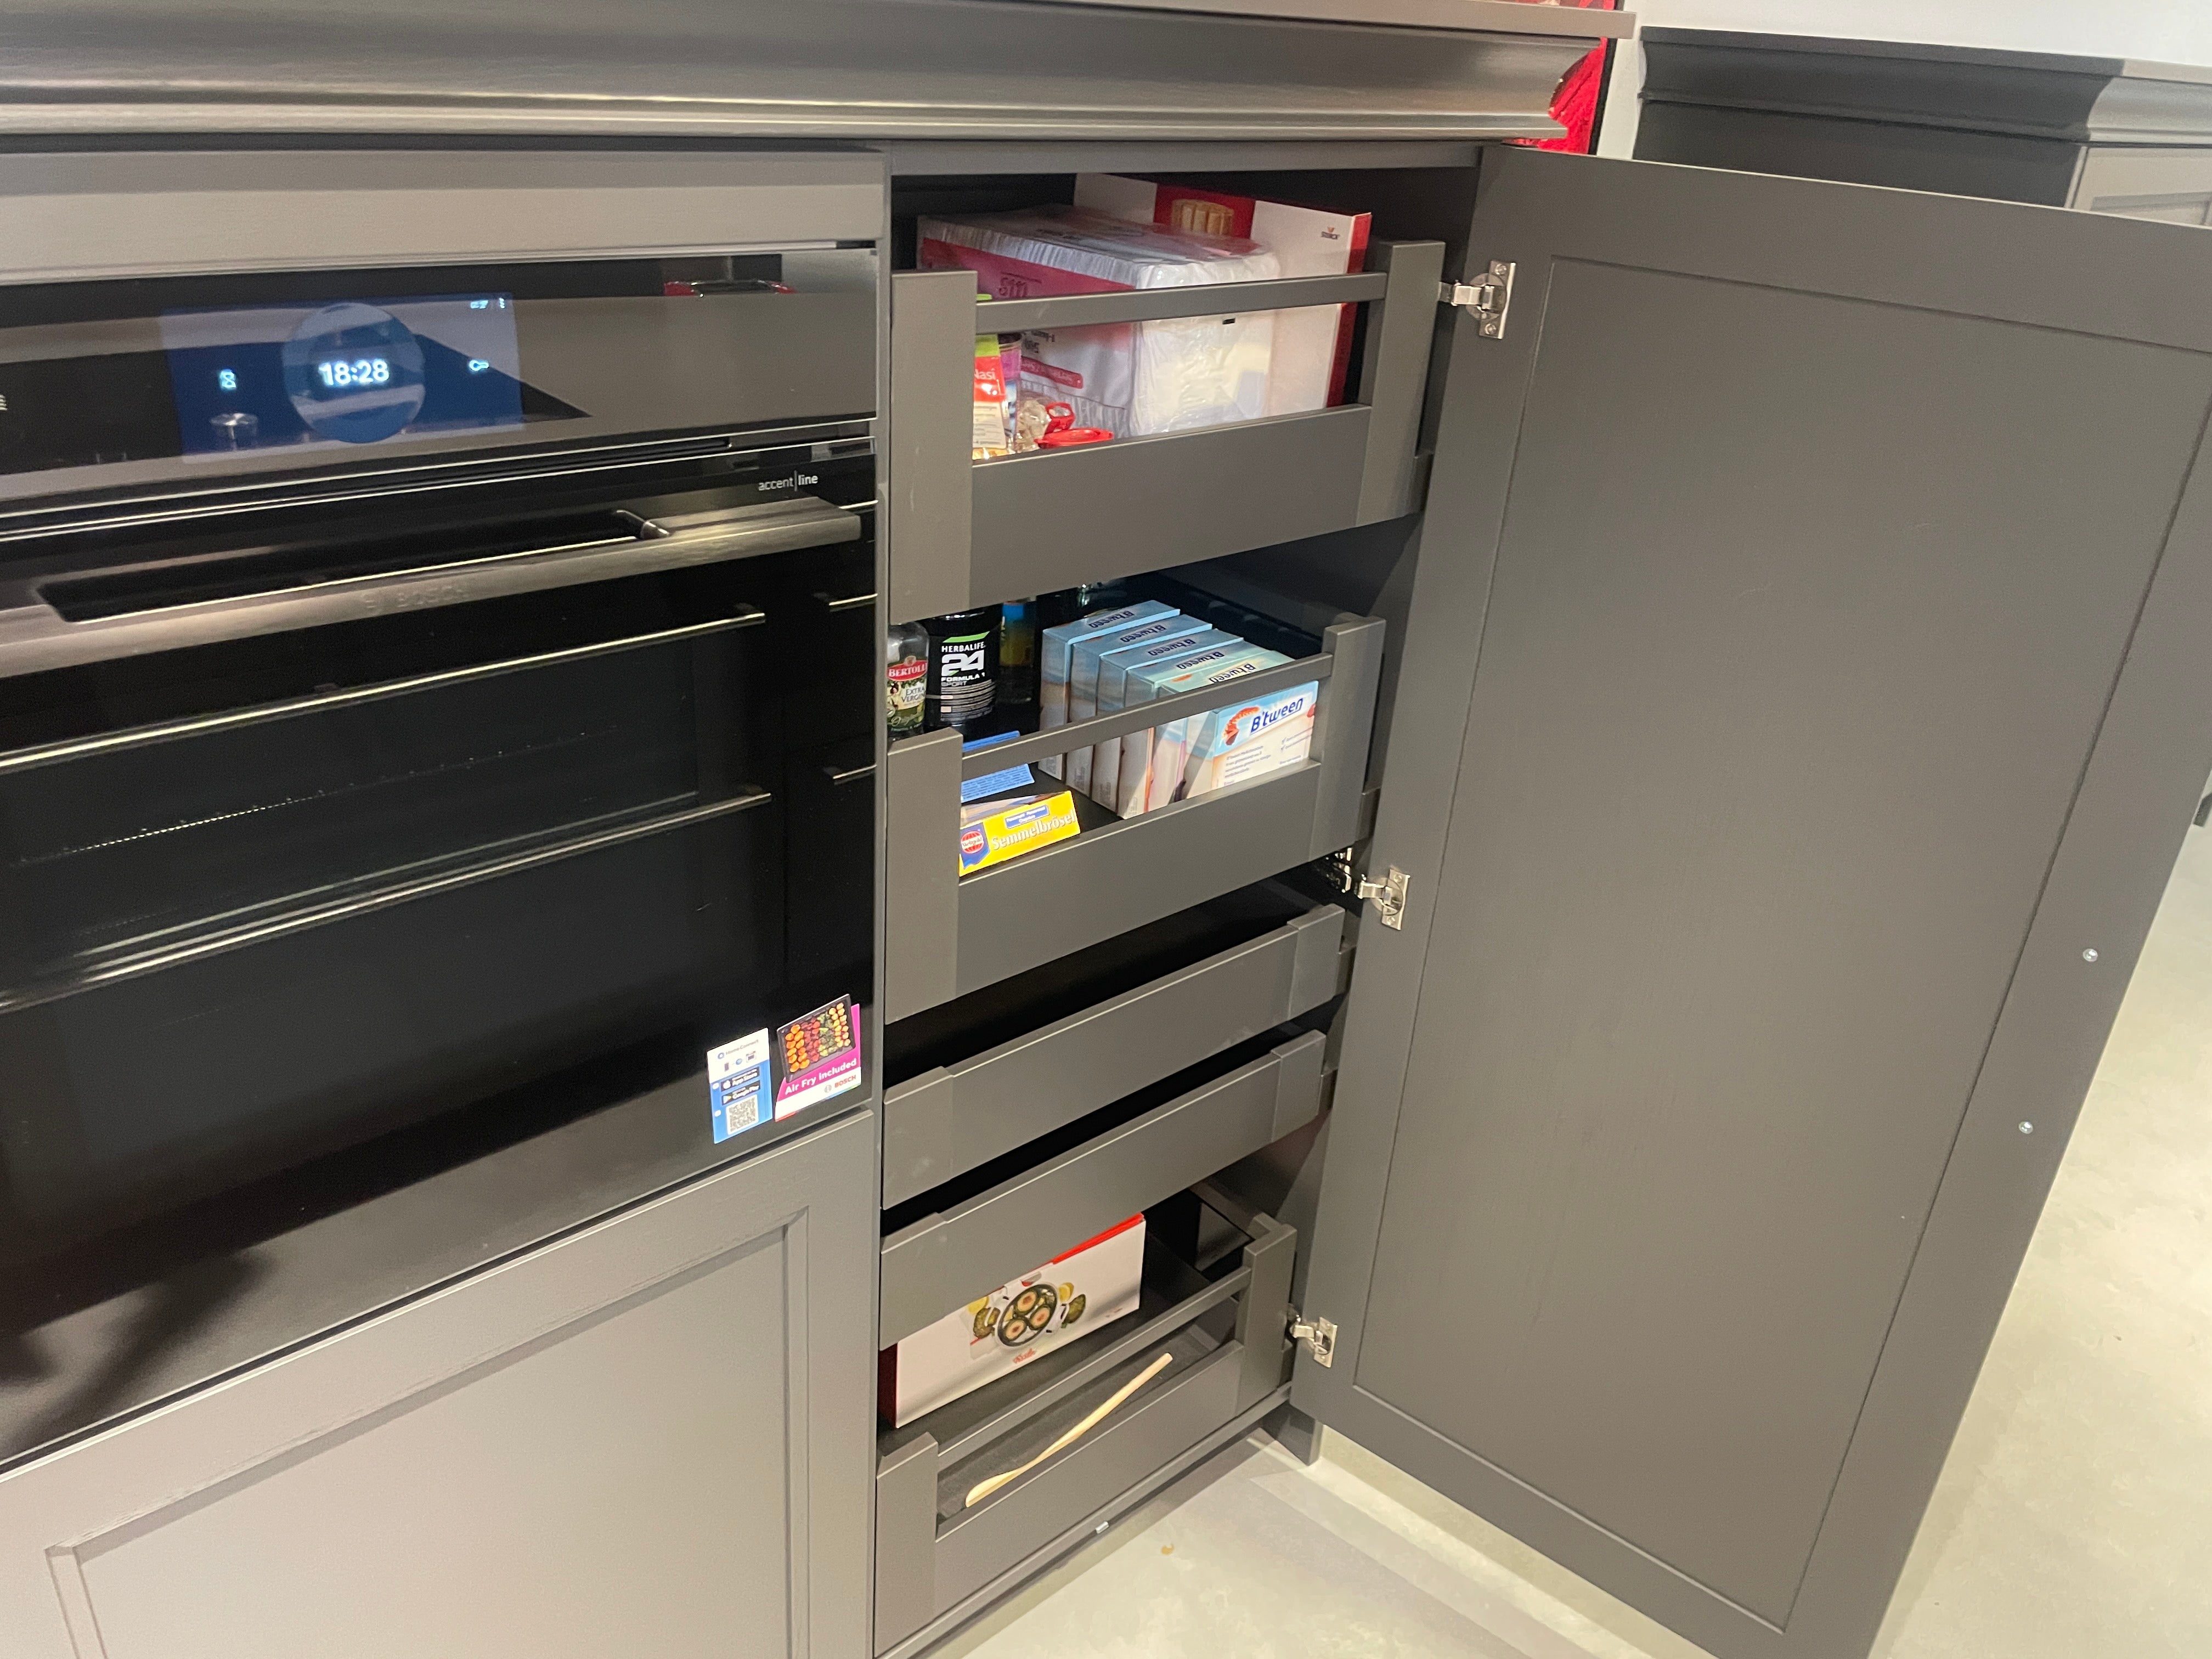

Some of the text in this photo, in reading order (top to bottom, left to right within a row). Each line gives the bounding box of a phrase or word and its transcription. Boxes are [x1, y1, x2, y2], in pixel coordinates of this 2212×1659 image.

[318, 359, 389, 385] 18:28
[941, 650, 985, 676] 24
[941, 673, 980, 682] FORMULA
[1250, 697, 1304, 733] B'tween
[991, 809, 1076, 850] Semmelbrösel
[785, 1058, 857, 1095] Air Fry included
[834, 1074, 856, 1088] BOSCH
